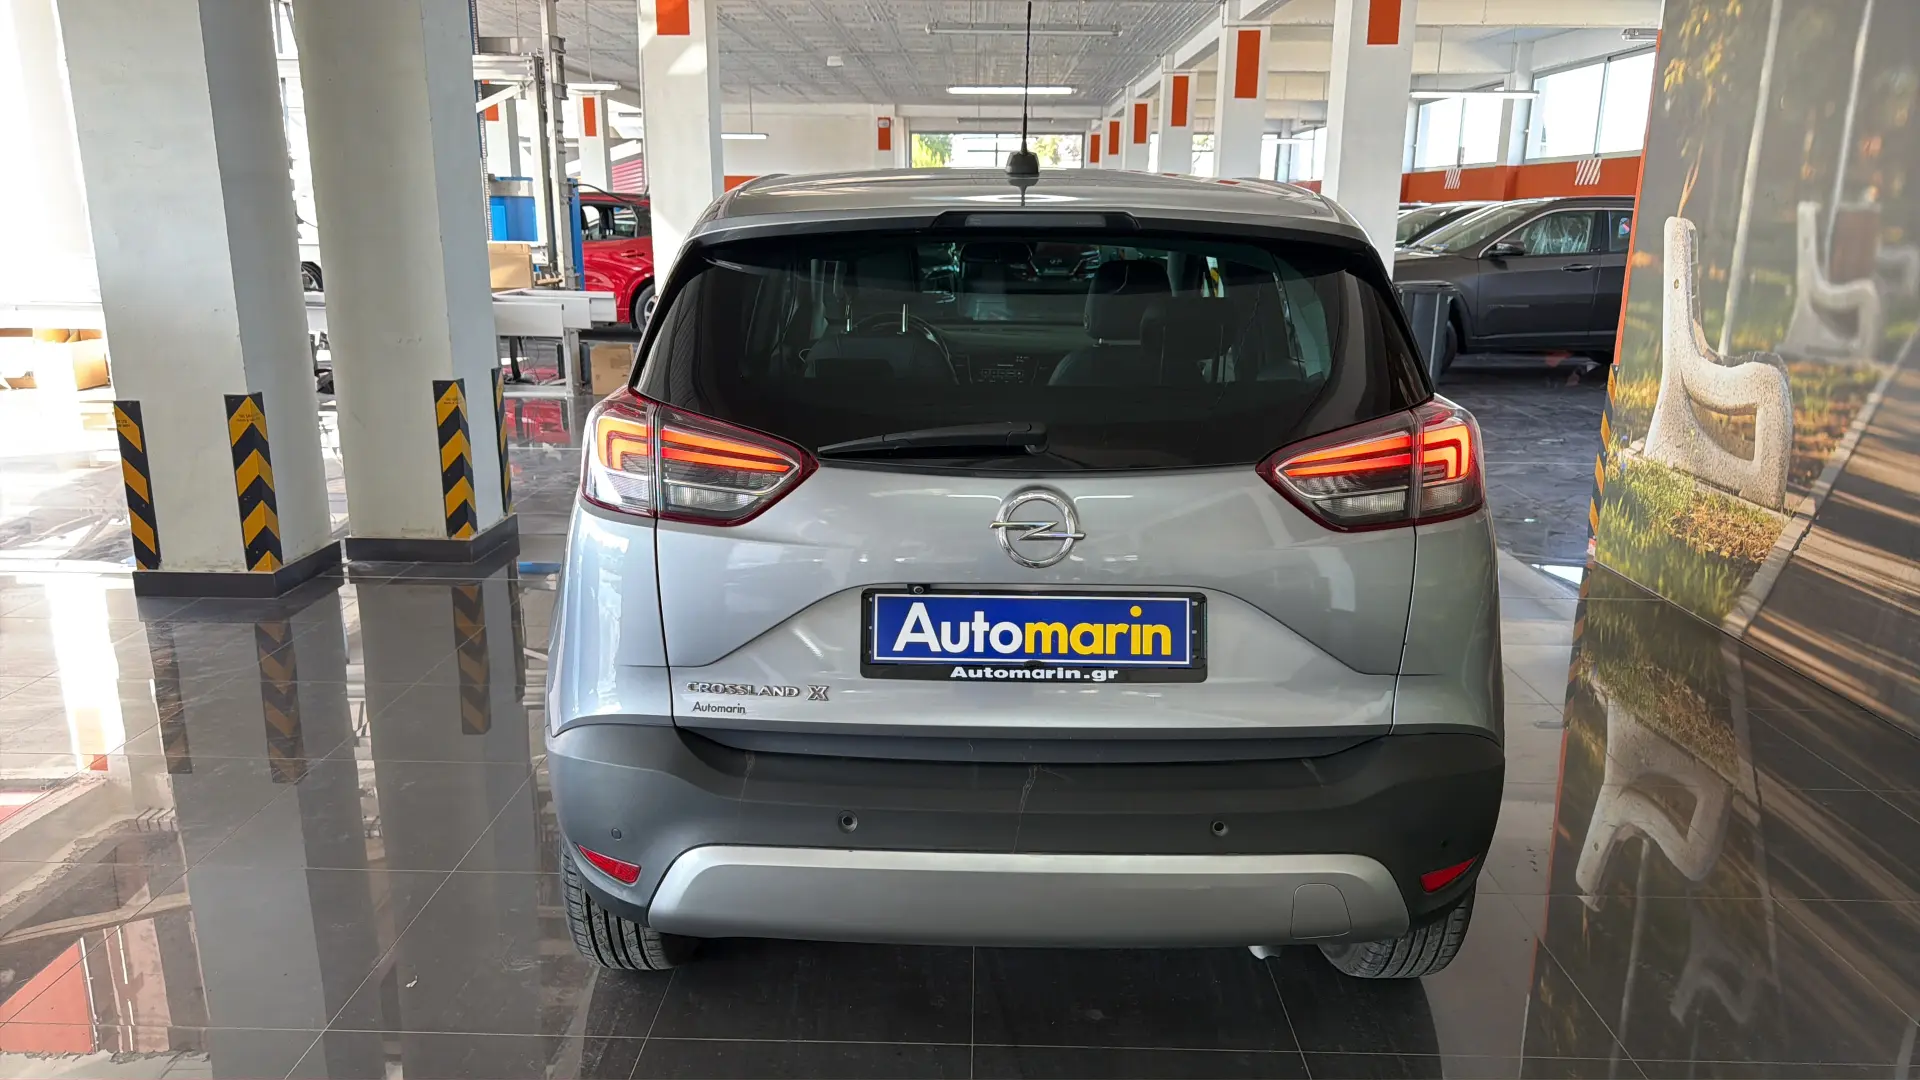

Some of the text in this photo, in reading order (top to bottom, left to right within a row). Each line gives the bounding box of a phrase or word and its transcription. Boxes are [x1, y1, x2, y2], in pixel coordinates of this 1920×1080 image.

[892, 602, 1172, 655] Automarin
[950, 666, 1119, 682] Automarin.gr
[686, 682, 829, 701] CROSSLAND X
[692, 701, 746, 714] Automarin
